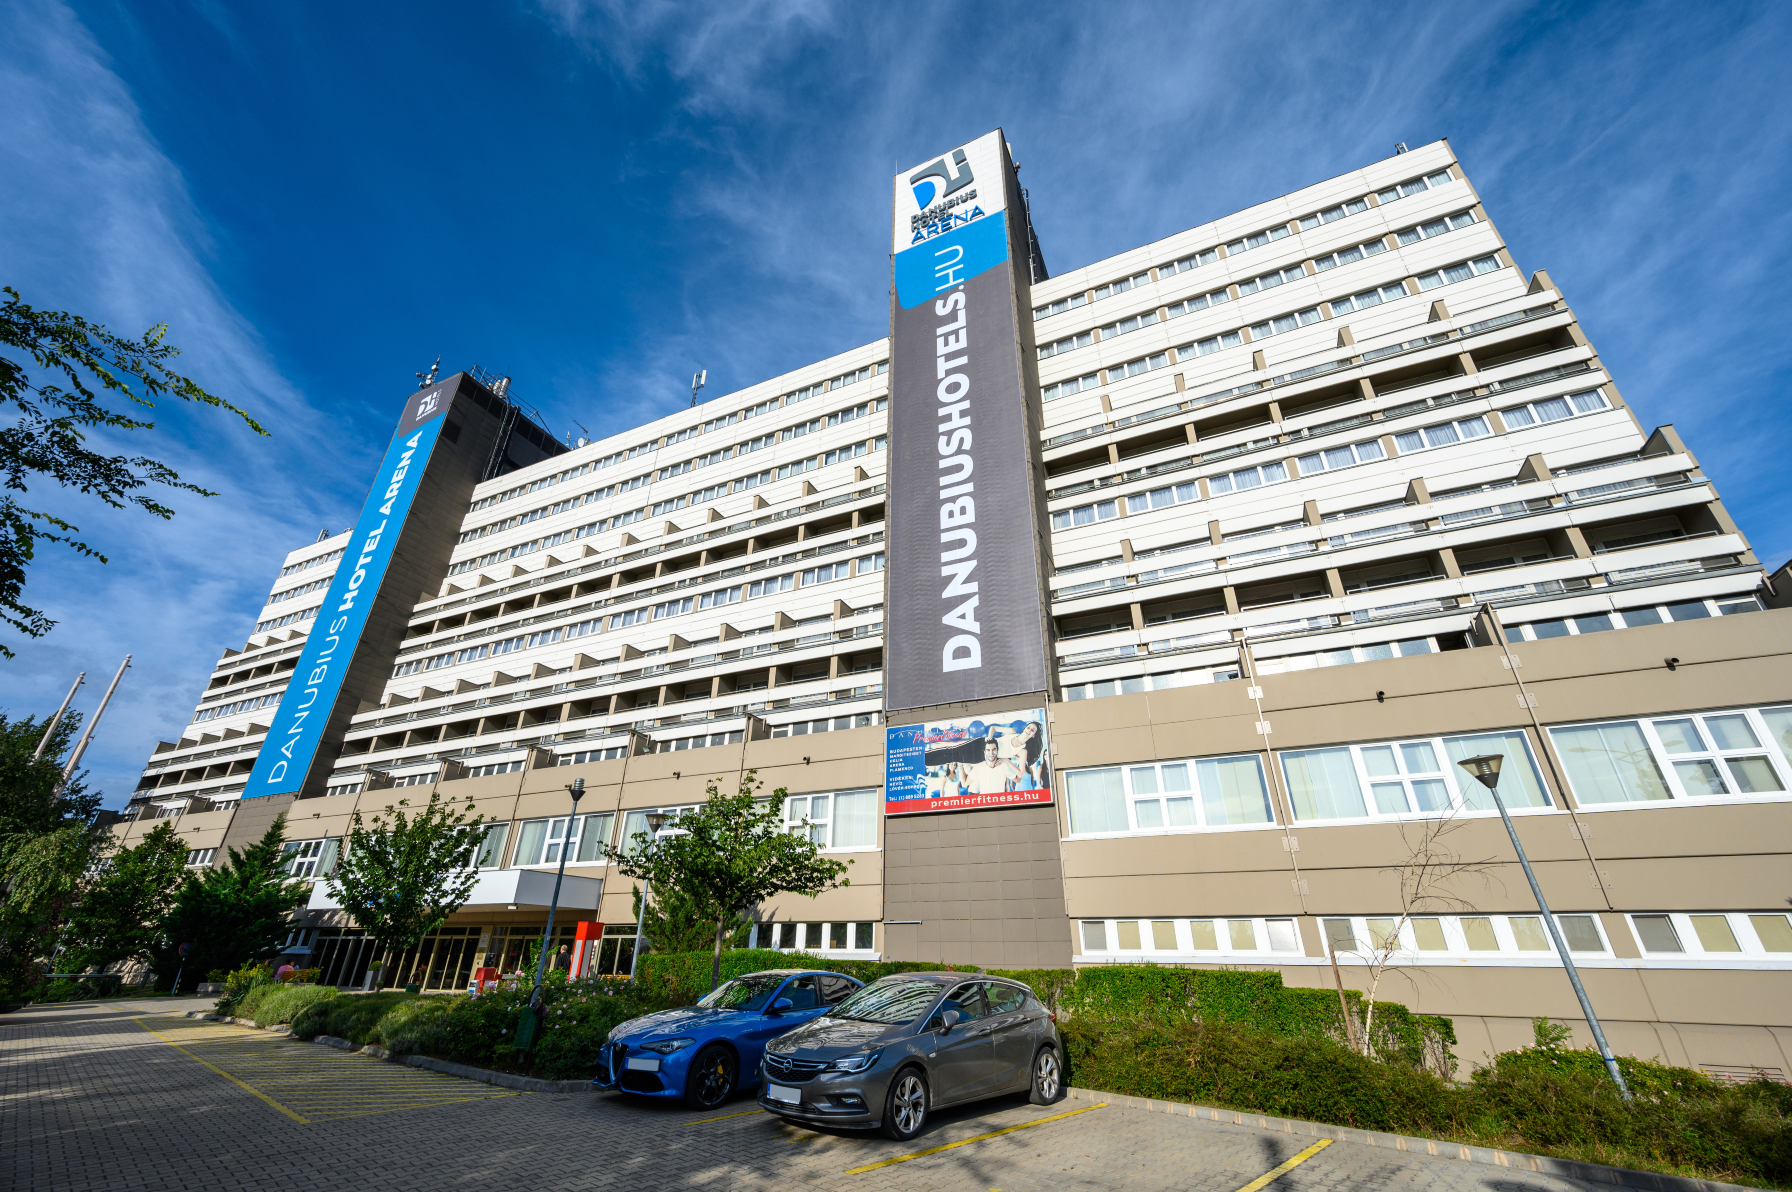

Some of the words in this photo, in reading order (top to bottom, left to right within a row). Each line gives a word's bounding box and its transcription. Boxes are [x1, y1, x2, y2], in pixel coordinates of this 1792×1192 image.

[911, 189, 977, 224] DANUBIUS
[911, 209, 953, 233] HOTEL
[911, 205, 985, 245] ARENA
[934, 245, 982, 673] DANUBIUSHOTELS.HU
[267, 615, 348, 784] DANUBIUS
[337, 518, 387, 612] HOTEL
[382, 430, 423, 516] ARENA
[931, 792, 1039, 808] premierfitness.hu
